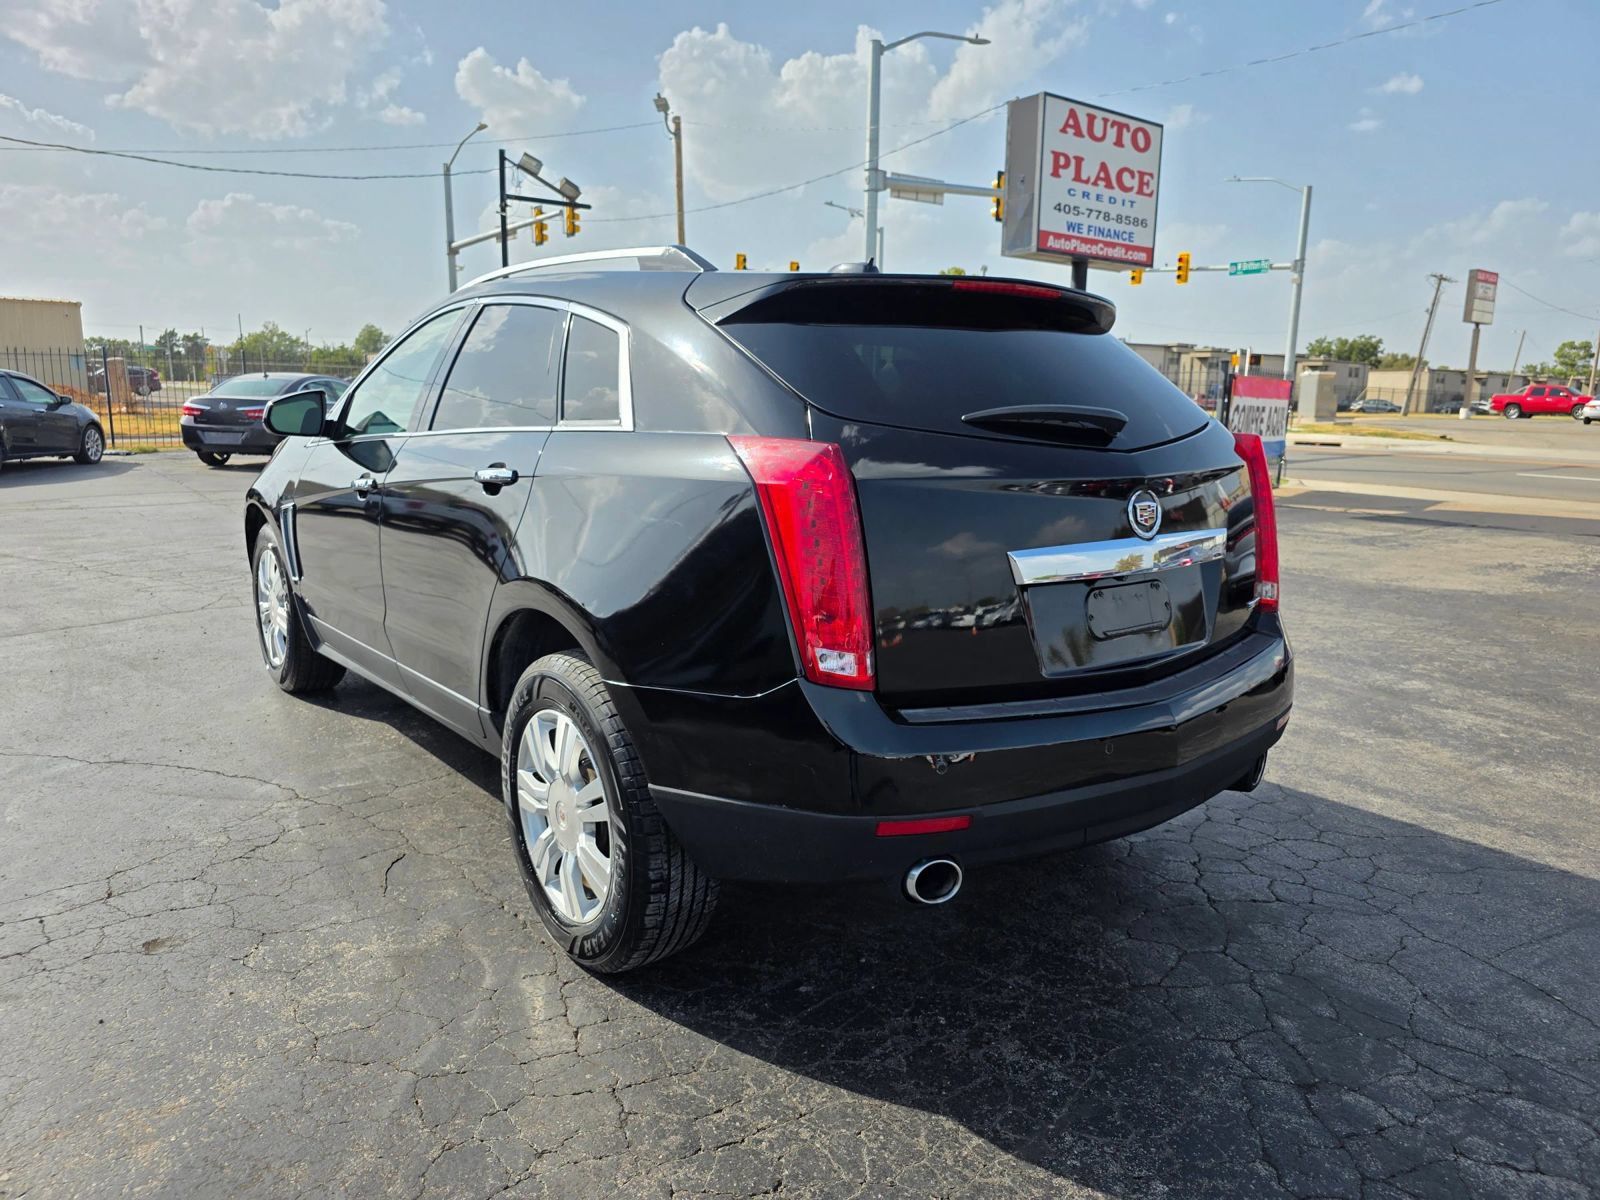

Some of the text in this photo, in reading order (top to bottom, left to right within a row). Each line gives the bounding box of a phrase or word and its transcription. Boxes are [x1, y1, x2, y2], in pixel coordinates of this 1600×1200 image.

[1059, 108, 1151, 153] AUTO
[1050, 150, 1154, 197] PLACE
[1067, 188, 1136, 208] CREDIT
[1053, 202, 1148, 228] 405-778-8586
[1066, 221, 1134, 242] WE FINANCE
[1047, 235, 1146, 260] AutoPlaceCredit.com
